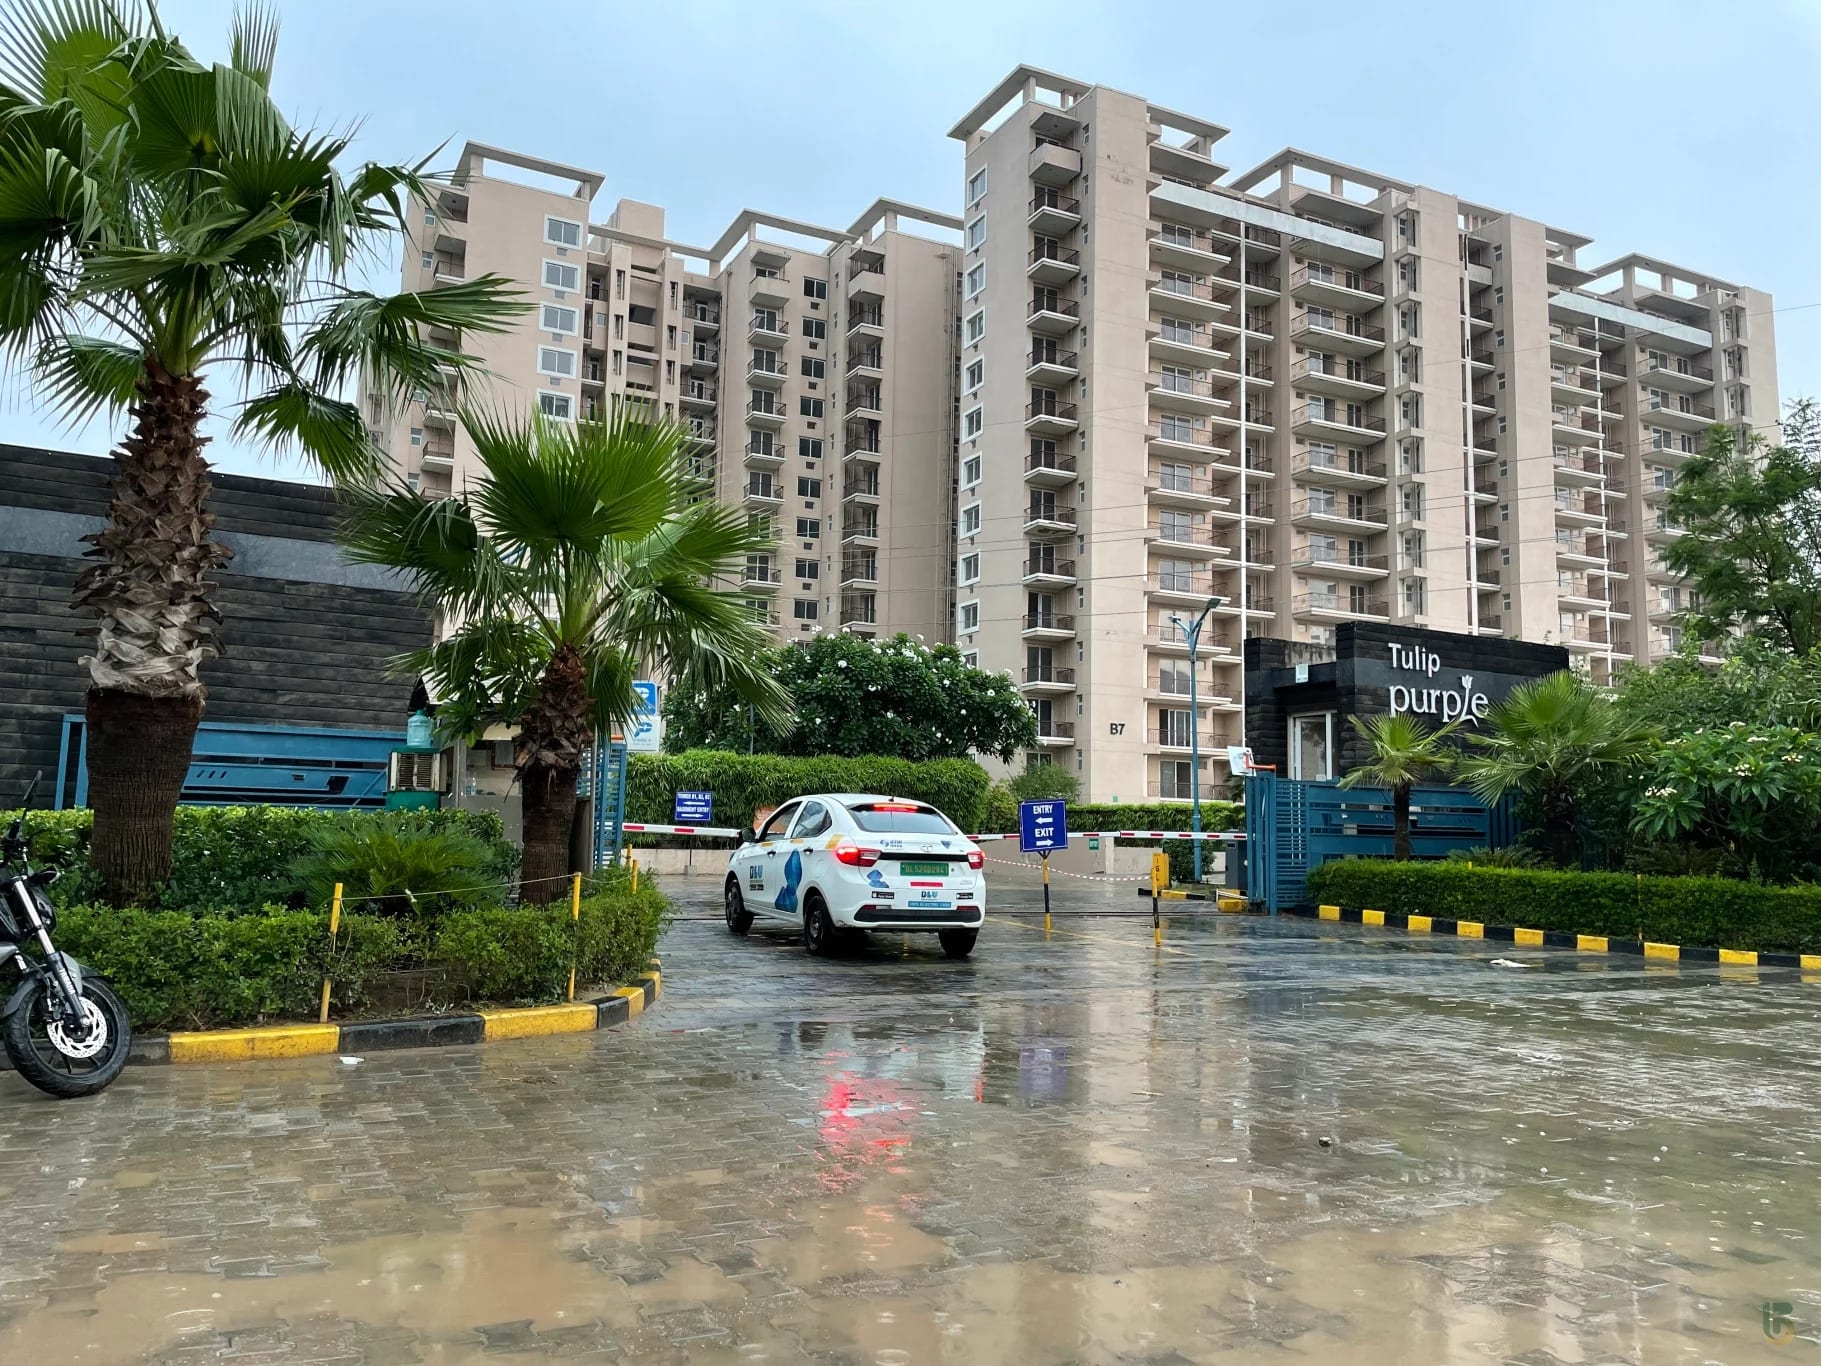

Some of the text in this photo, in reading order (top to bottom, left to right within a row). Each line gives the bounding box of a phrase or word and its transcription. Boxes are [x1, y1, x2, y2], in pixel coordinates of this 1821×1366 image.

[1388, 642, 1440, 678] Tulip
[1389, 674, 1489, 728] purple
[1110, 722, 1126, 736] B7
[1033, 804, 1053, 815] ENTRY
[1034, 827, 1054, 838] EXIT
